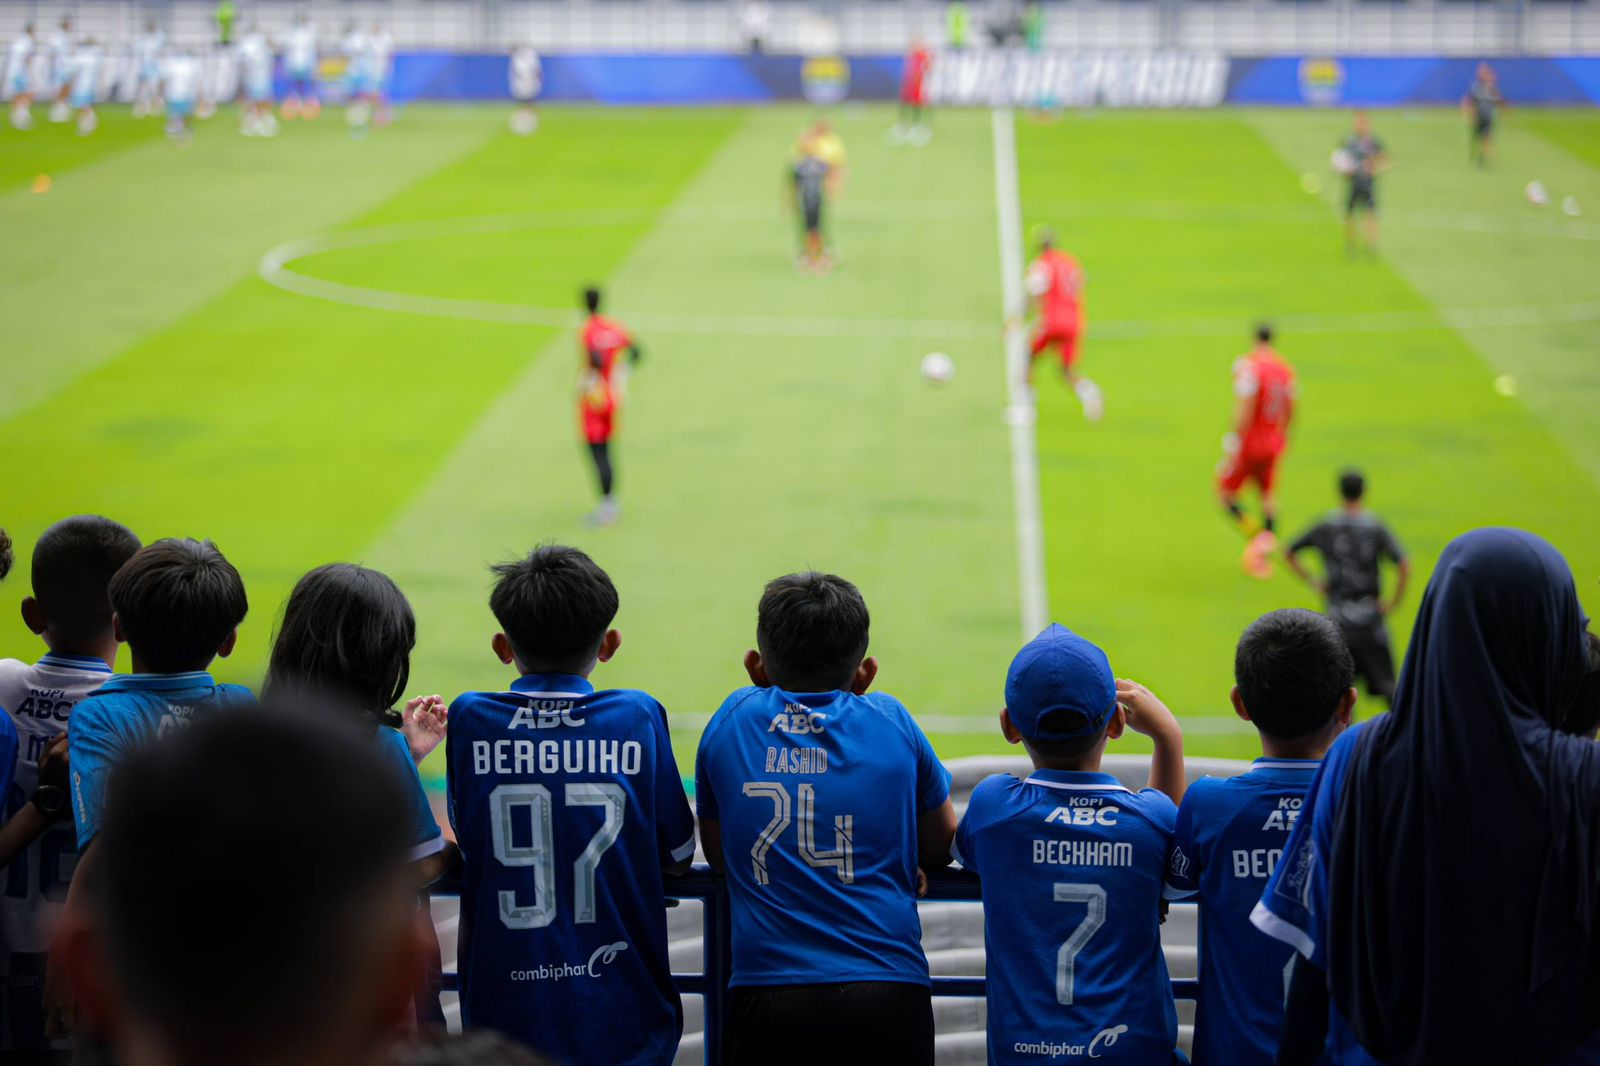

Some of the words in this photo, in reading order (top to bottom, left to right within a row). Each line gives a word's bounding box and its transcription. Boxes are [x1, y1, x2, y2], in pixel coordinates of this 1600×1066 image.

[15, 697, 72, 722] ABC
[527, 699, 574, 711] KOPI
[507, 706, 586, 729] ABC
[767, 712, 827, 735] ABC
[472, 739, 642, 775] BERGUIHO
[765, 746, 828, 774] RASHID
[1069, 796, 1103, 807] KOPI
[1277, 797, 1303, 809] KO
[1045, 806, 1119, 826] ABC
[742, 781, 854, 886] 74
[488, 783, 627, 930] 97
[1033, 839, 1133, 867] BECKHAM
[1053, 882, 1108, 1006] 7
[510, 961, 587, 981] combiphar
[1014, 1041, 1085, 1058] combiphar
